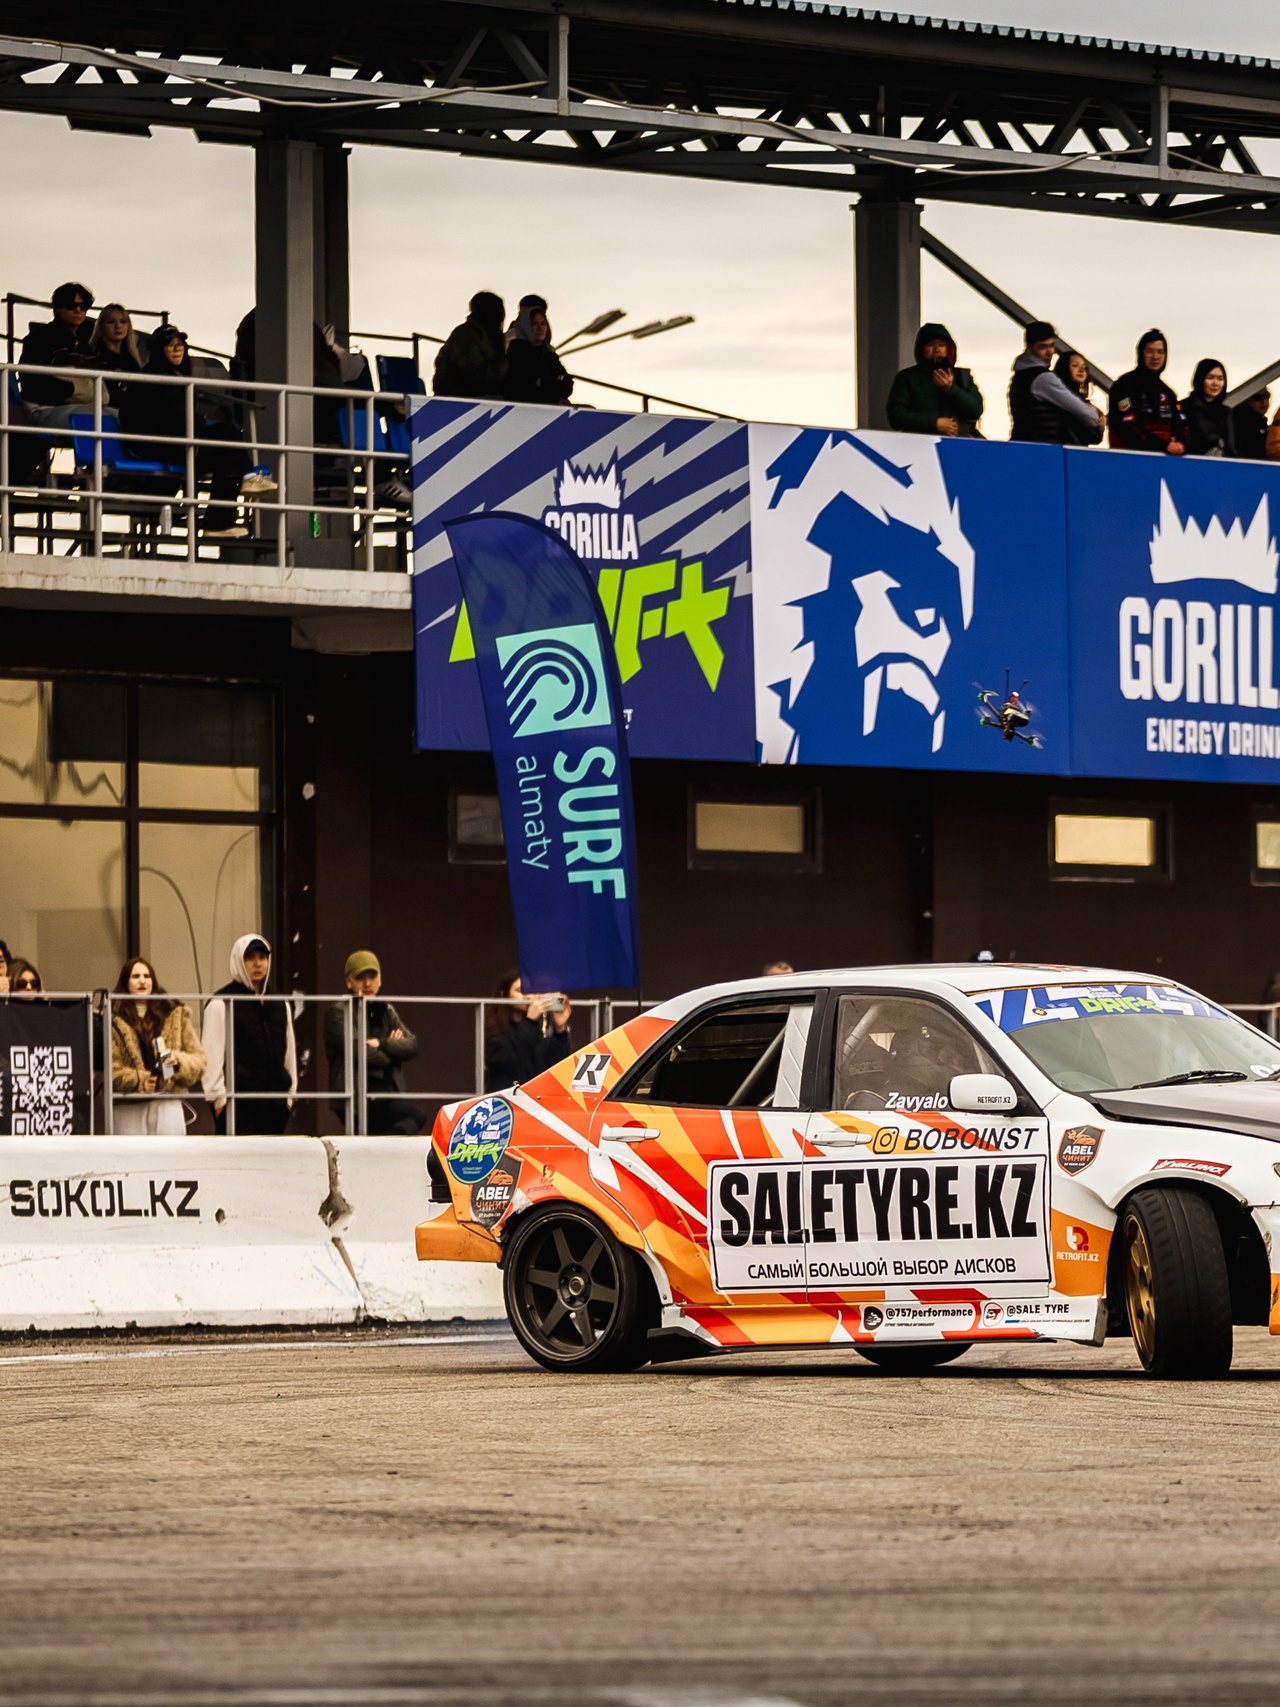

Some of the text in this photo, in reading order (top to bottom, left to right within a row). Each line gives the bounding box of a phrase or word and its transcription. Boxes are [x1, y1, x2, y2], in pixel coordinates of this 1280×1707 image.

[1146, 717, 1226, 756] ENERGY
[515, 755, 552, 870] almaty
[552, 746, 627, 899] SURF
[1077, 996, 1165, 1014] DRIFT
[977, 1096, 1011, 1104] RETROFIT.KZ
[903, 1127, 1040, 1151] BOBOINST
[448, 1142, 503, 1163] DRIFT
[1063, 1145, 1094, 1155] ABEL
[9, 1179, 201, 1218] SOKOL.KZ
[476, 1186, 510, 1201] ABEL
[719, 1163, 1037, 1247] SALETYRE.KZ
[1056, 1251, 1099, 1262] RETROFIT.KZ
[748, 1257, 1017, 1279] САМЫЙ БОЛЬШОЙ ВЫБОР ДИСКОВ
[885, 1307, 974, 1320] @757performance
